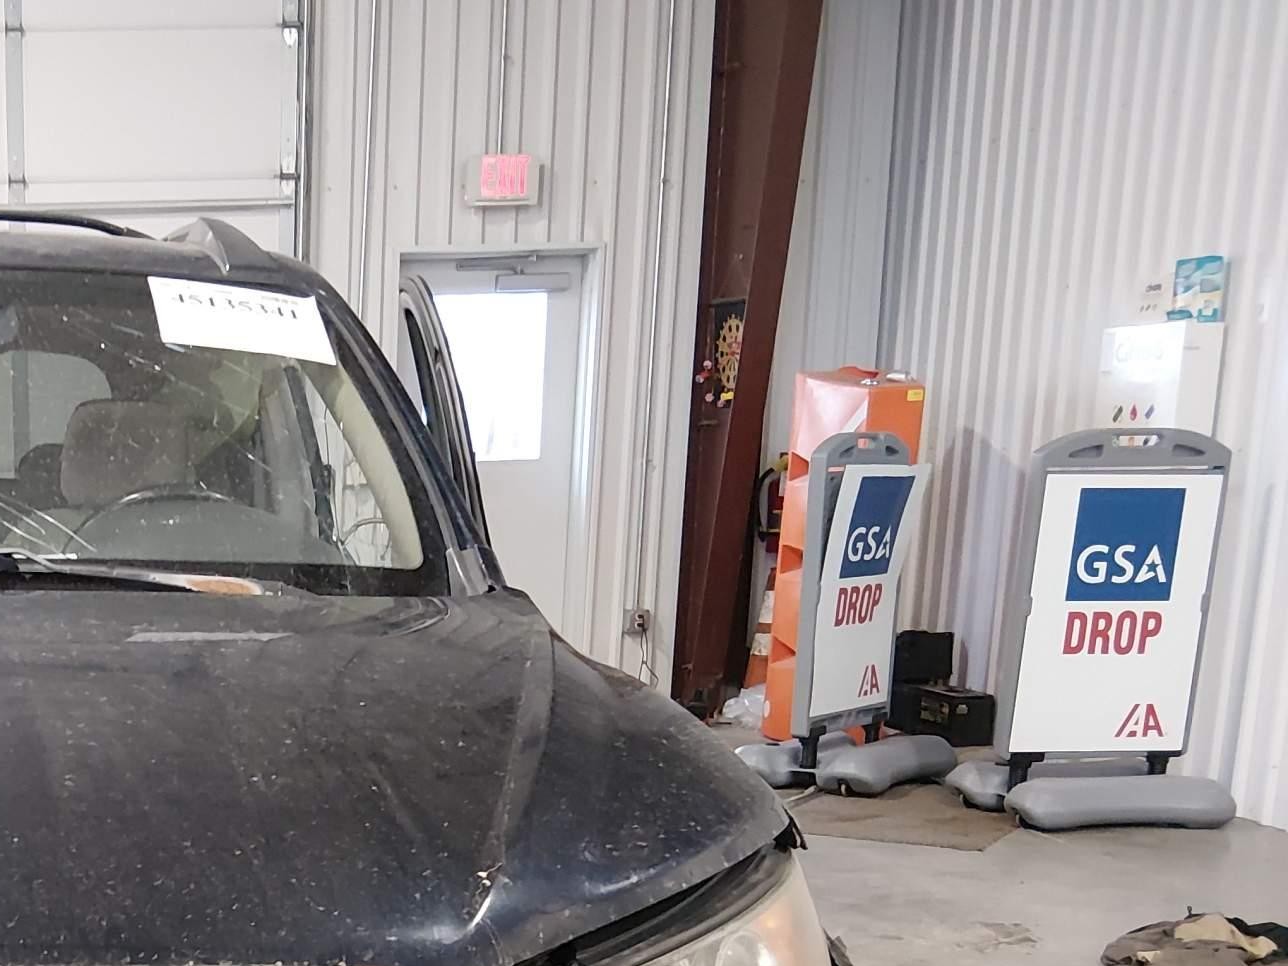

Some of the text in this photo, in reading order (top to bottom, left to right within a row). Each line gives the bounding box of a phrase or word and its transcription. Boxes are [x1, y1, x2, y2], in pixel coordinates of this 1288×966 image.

[480, 154, 530, 198] EXIT
[847, 525, 892, 562] GSA
[1076, 544, 1167, 584] GSA
[834, 583, 883, 627] DROP
[1063, 610, 1163, 656] DROP
